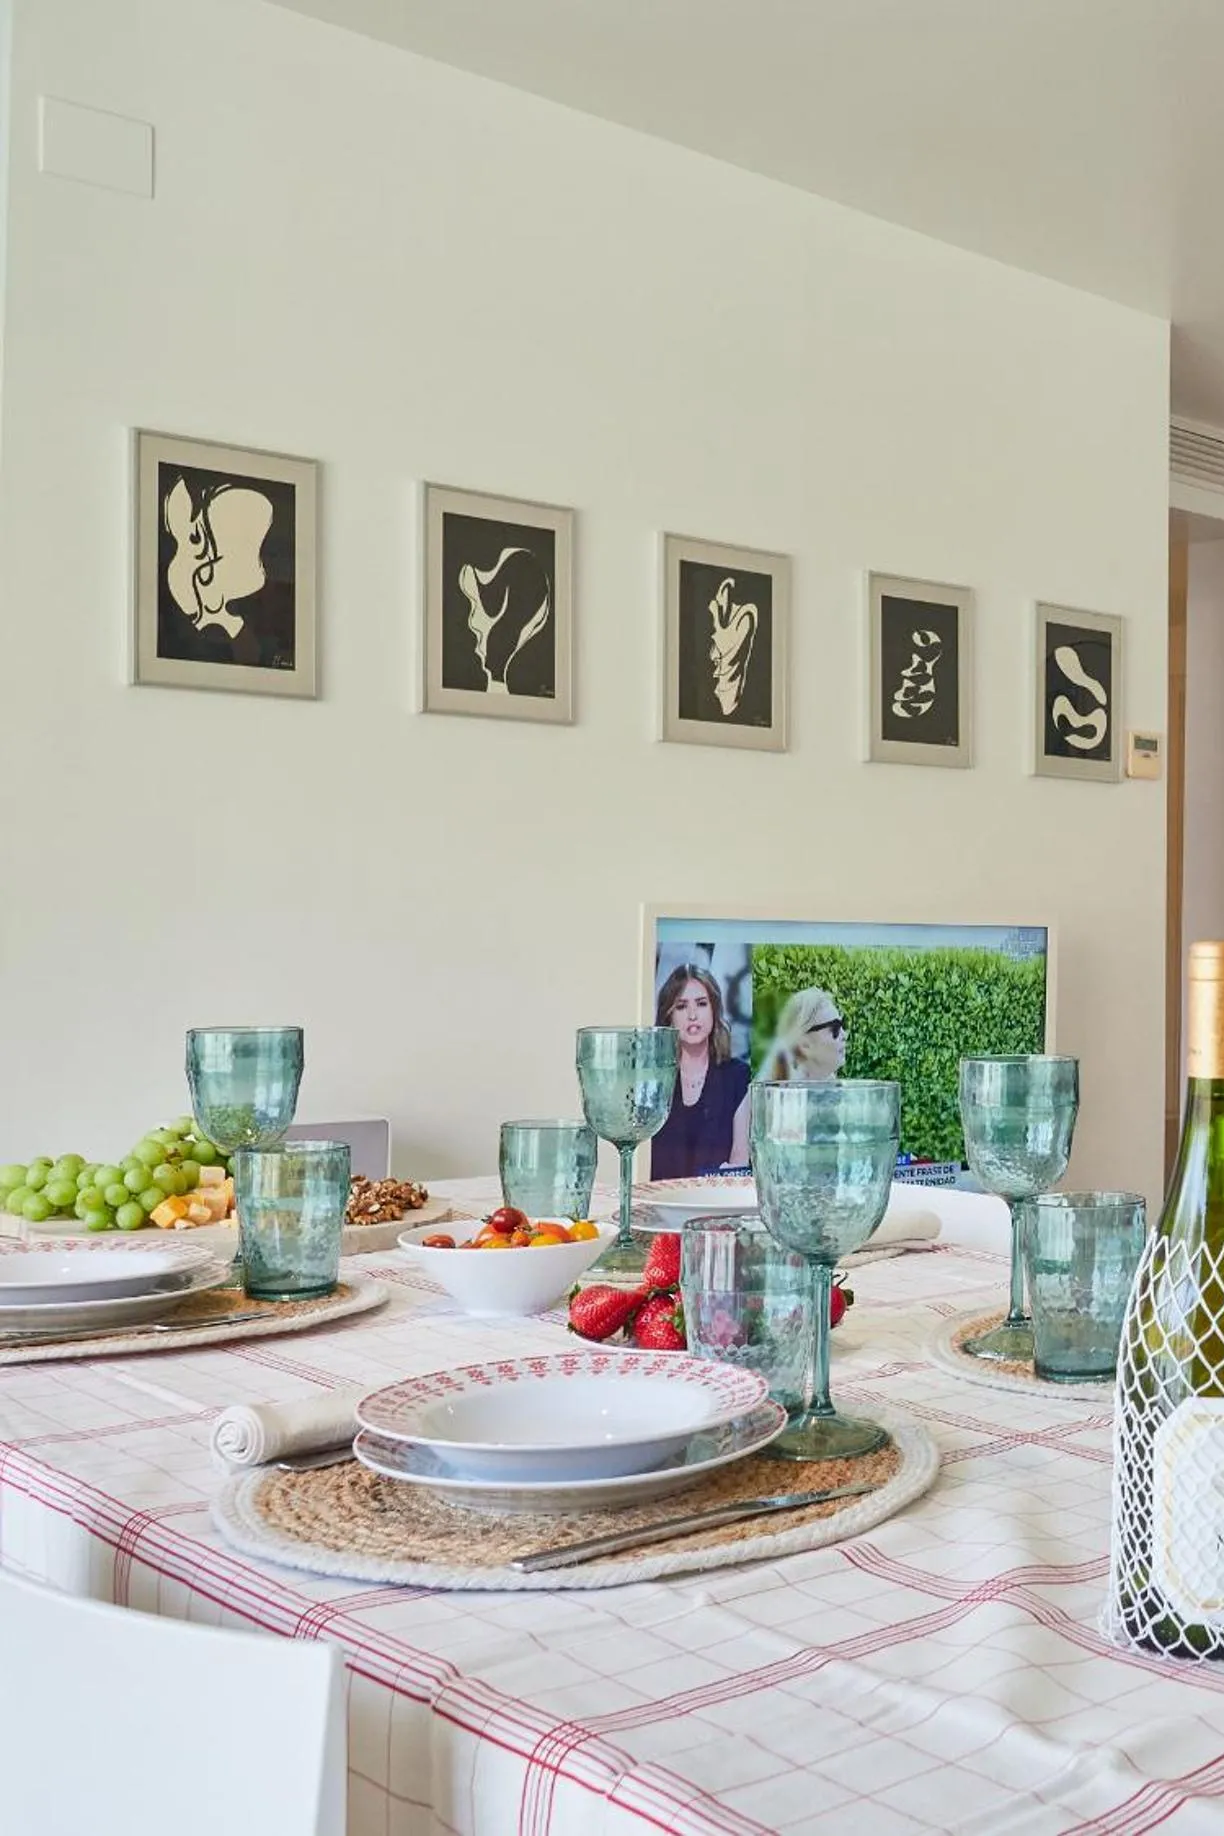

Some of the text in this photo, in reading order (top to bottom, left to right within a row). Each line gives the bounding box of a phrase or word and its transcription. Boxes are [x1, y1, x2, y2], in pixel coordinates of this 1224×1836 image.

[917, 1166, 941, 1175] FRASE
[943, 1165, 955, 1174] DE
[902, 1176, 956, 1186] ATERNIDAD
